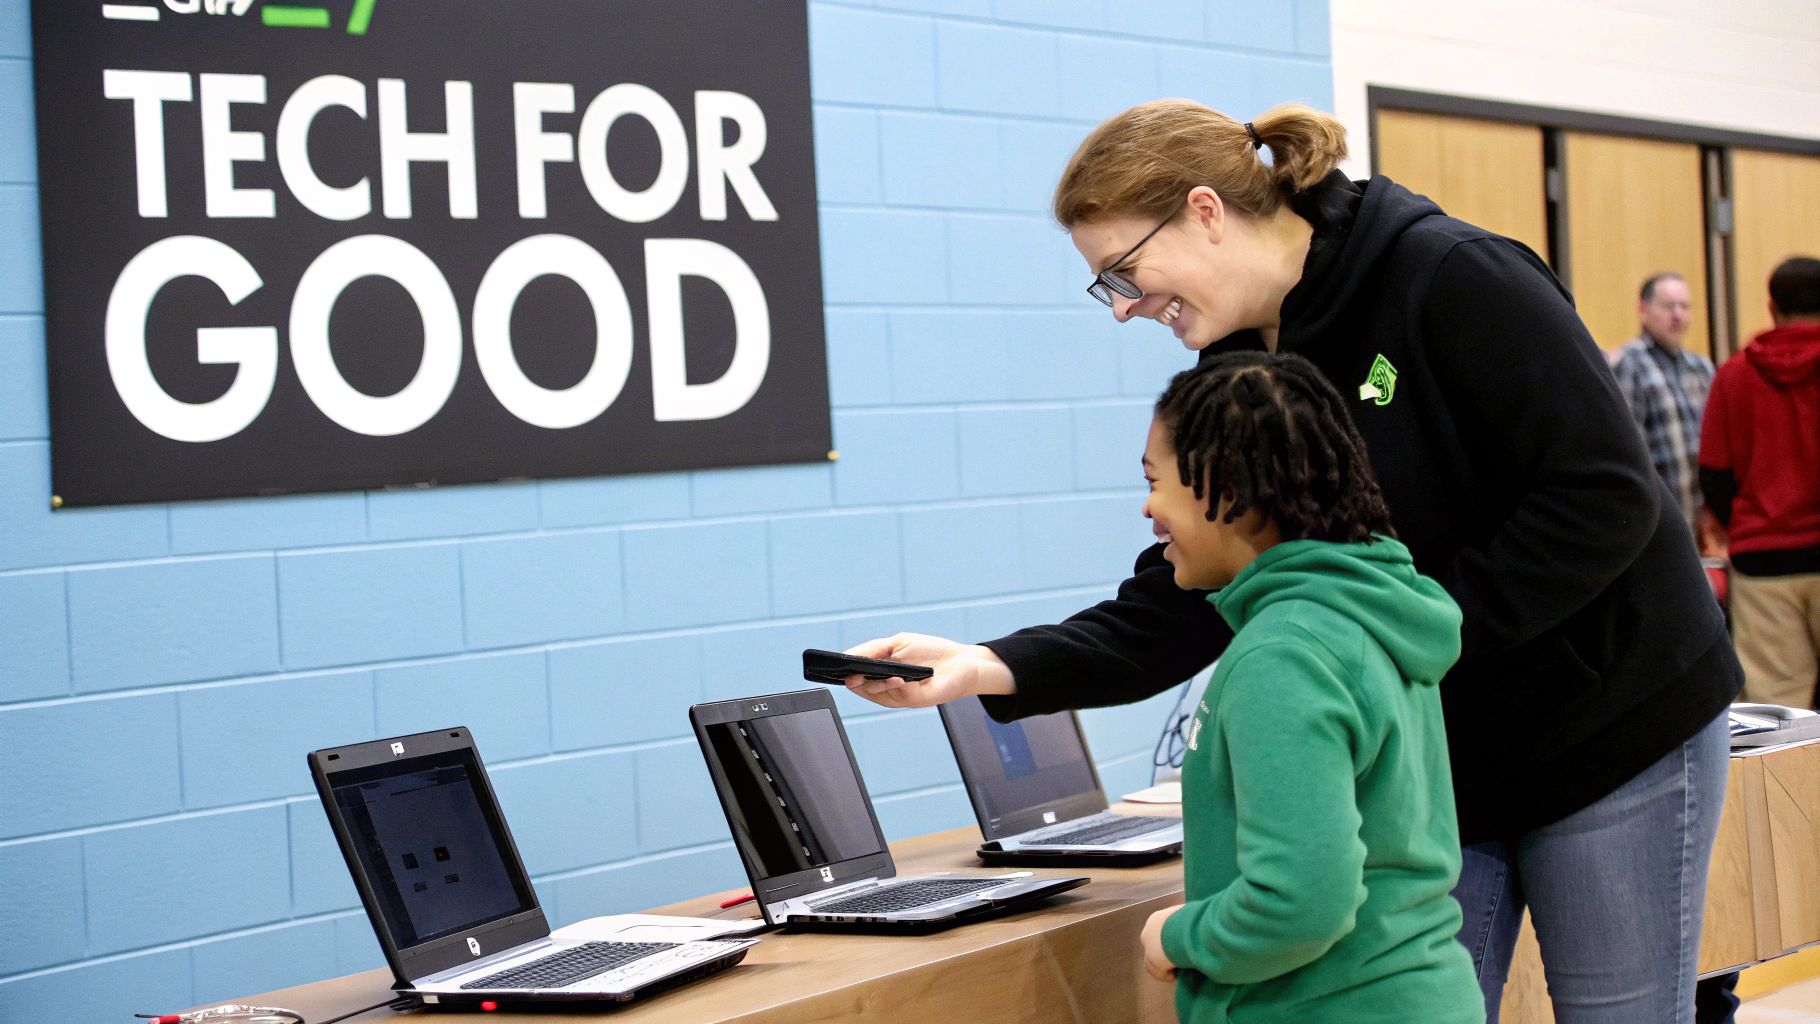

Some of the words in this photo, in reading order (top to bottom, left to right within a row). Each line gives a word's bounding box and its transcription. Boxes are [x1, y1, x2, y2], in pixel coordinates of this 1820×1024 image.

[103, 69, 478, 220] TECH
[512, 82, 778, 223] FOR
[105, 234, 771, 443] GOOD
